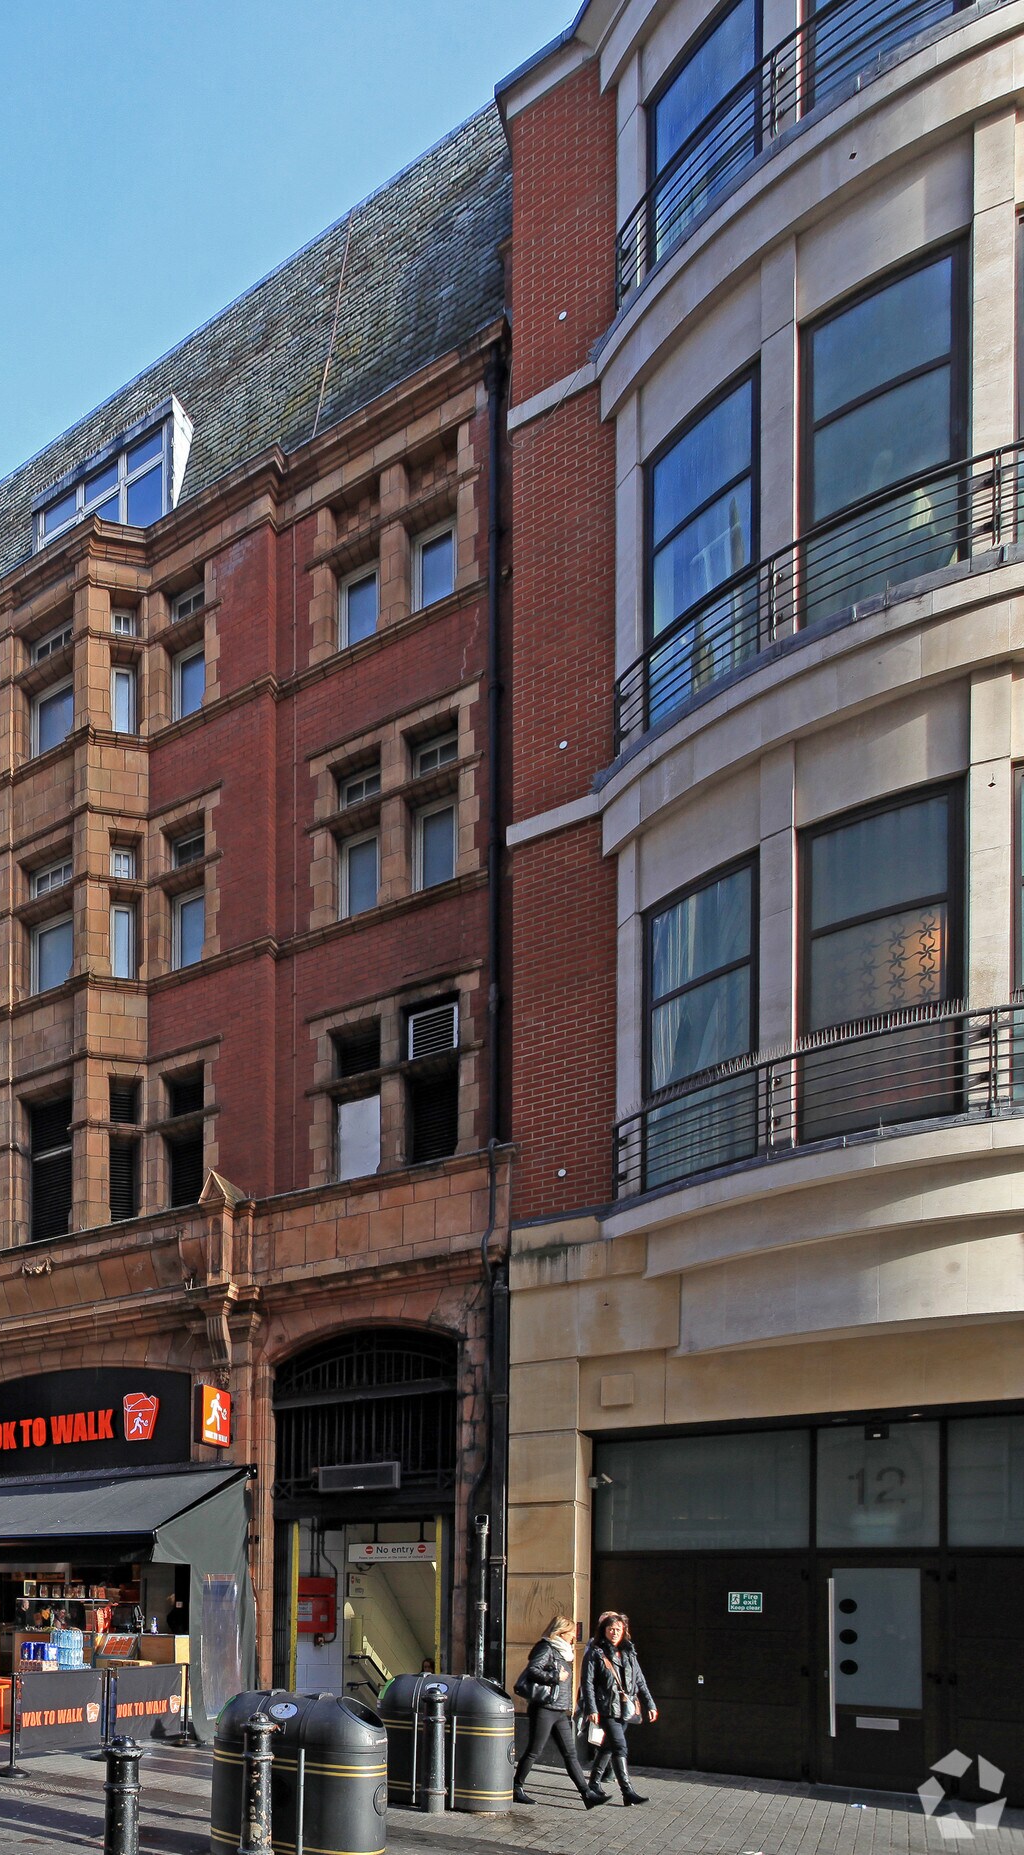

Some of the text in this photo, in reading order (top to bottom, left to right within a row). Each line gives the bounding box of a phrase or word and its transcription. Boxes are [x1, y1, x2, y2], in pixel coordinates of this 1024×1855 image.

[20, 1417, 47, 1447] TO
[50, 1409, 114, 1445] WALK
[848, 1466, 906, 1505] 12
[376, 1546, 415, 1555] No entry
[22, 1708, 83, 1728] WOK TO WALK
[116, 1700, 168, 1719] WOK TO WALK
